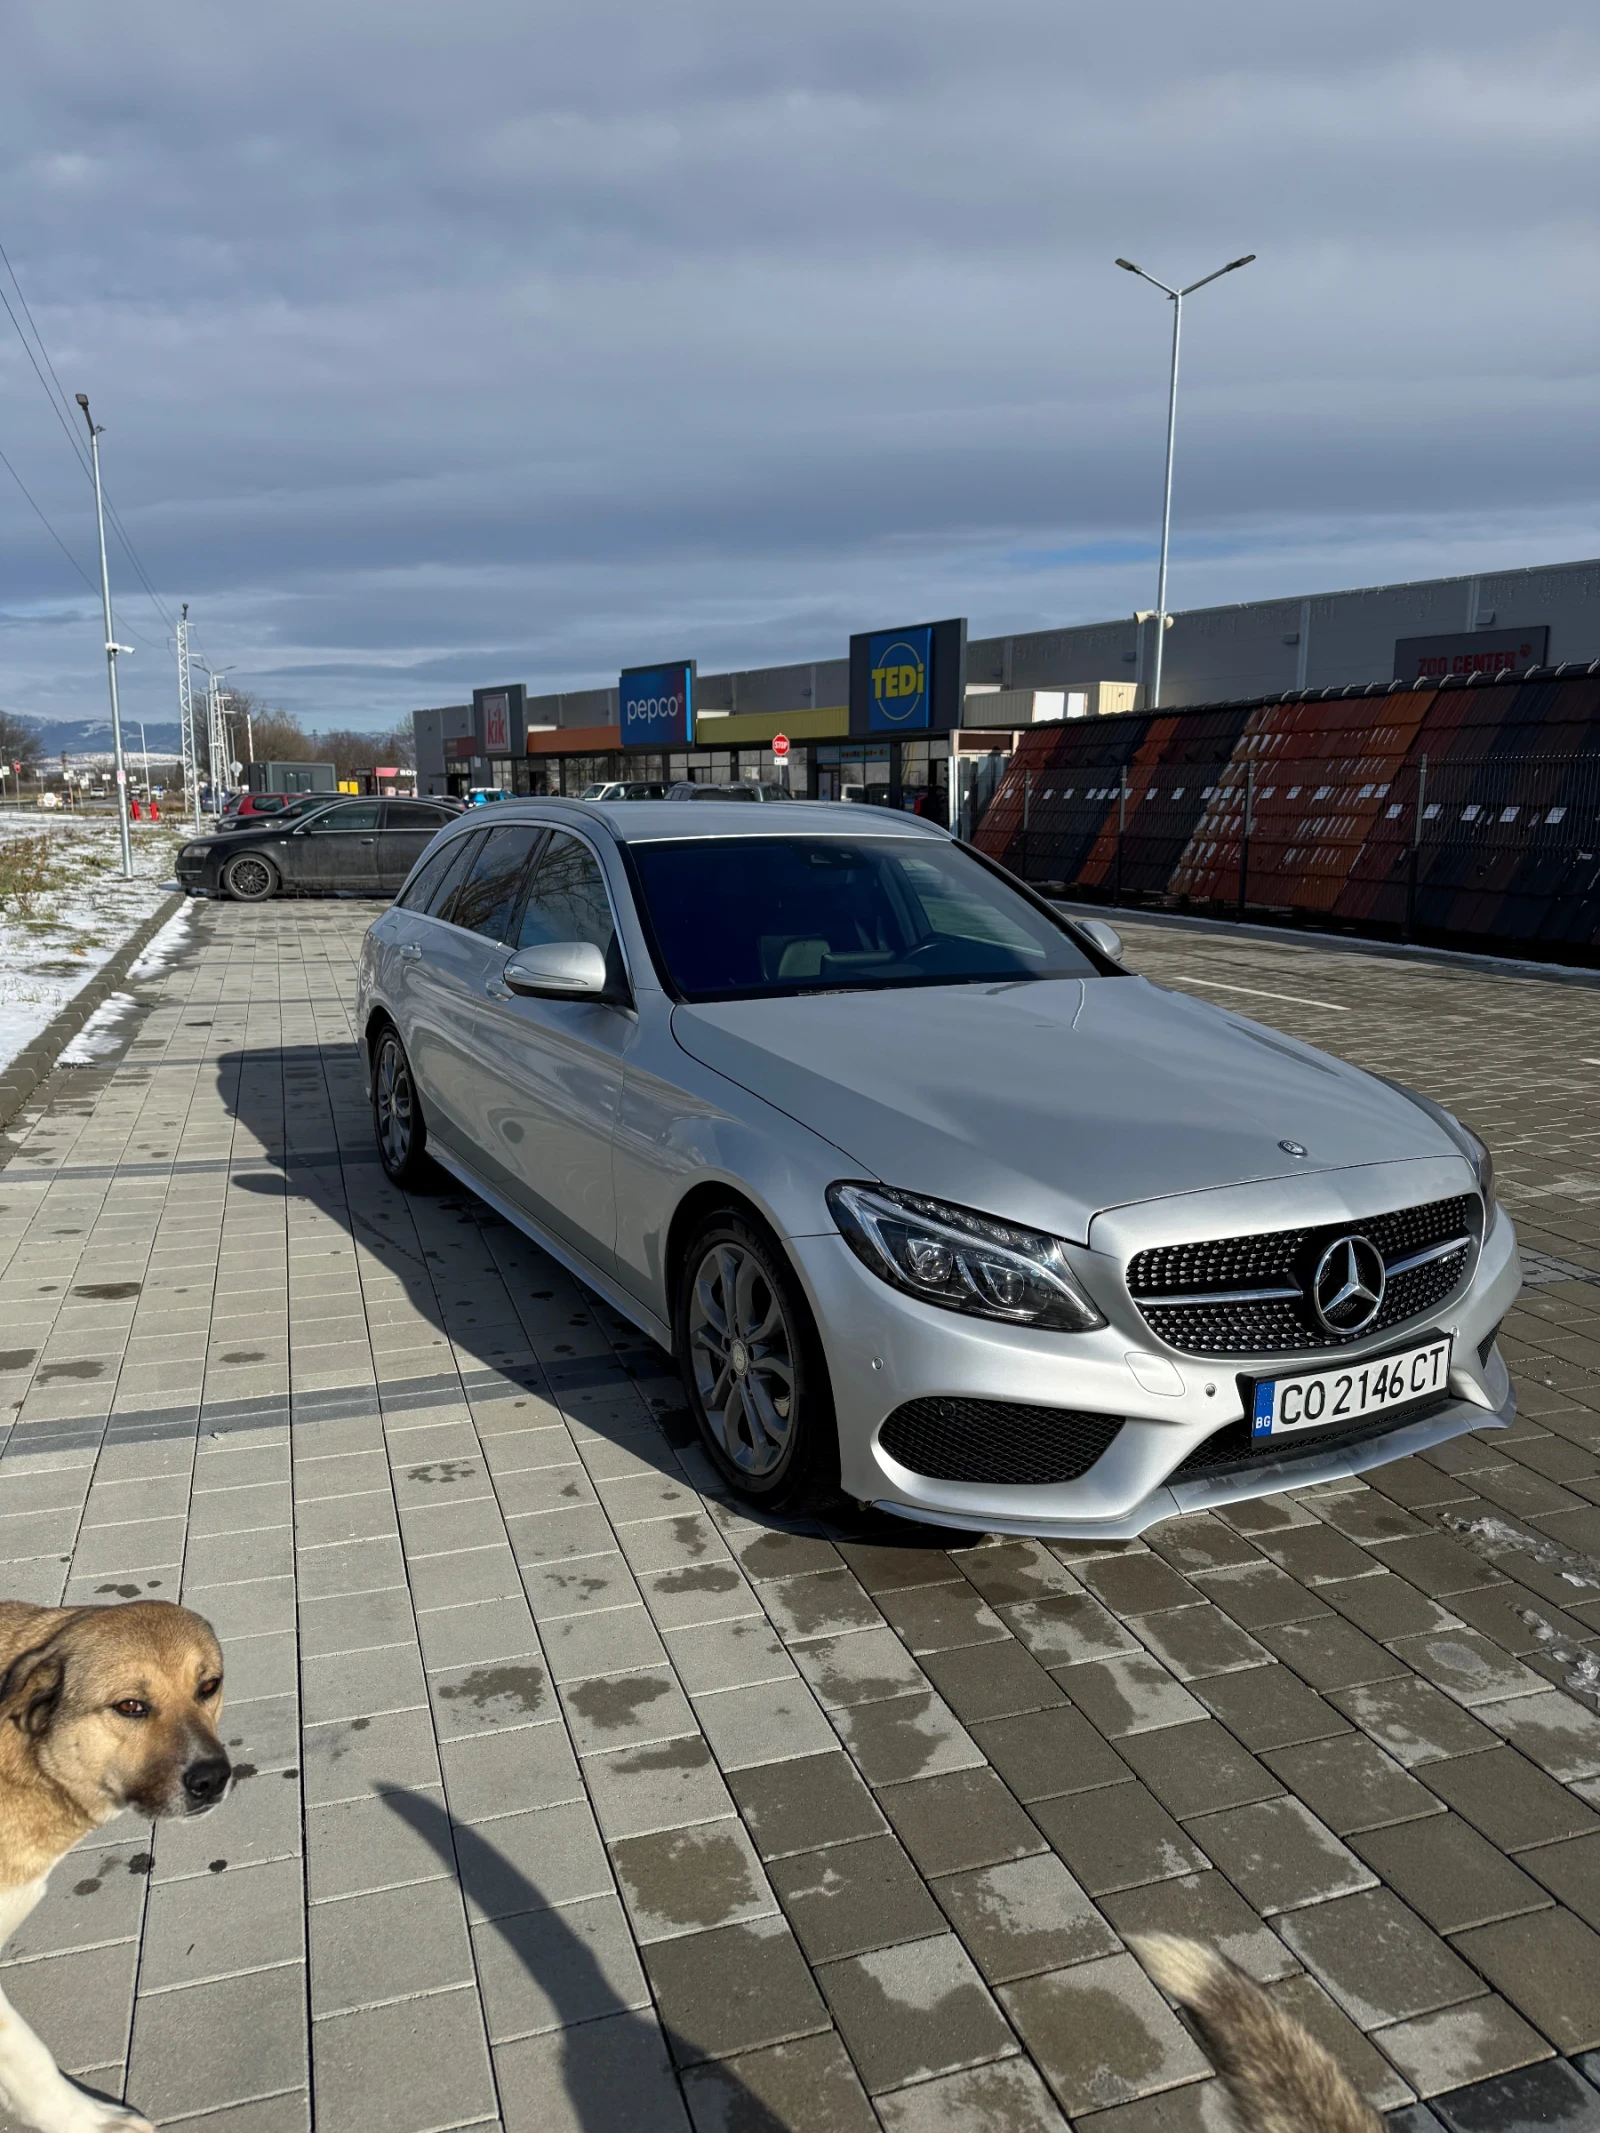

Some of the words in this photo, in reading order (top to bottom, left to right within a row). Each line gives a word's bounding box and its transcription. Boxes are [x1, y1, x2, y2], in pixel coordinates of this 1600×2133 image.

[1417, 657, 1448, 677] ZOO
[1453, 651, 1516, 674] CENTER
[871, 663, 924, 699] TEDi
[774, 741, 788, 749] STOP
[1280, 1380, 1325, 1424] CO
[1332, 1360, 1404, 1416] 2146
[1410, 1346, 1445, 1392] CT
[1255, 1415, 1271, 1429] BG
